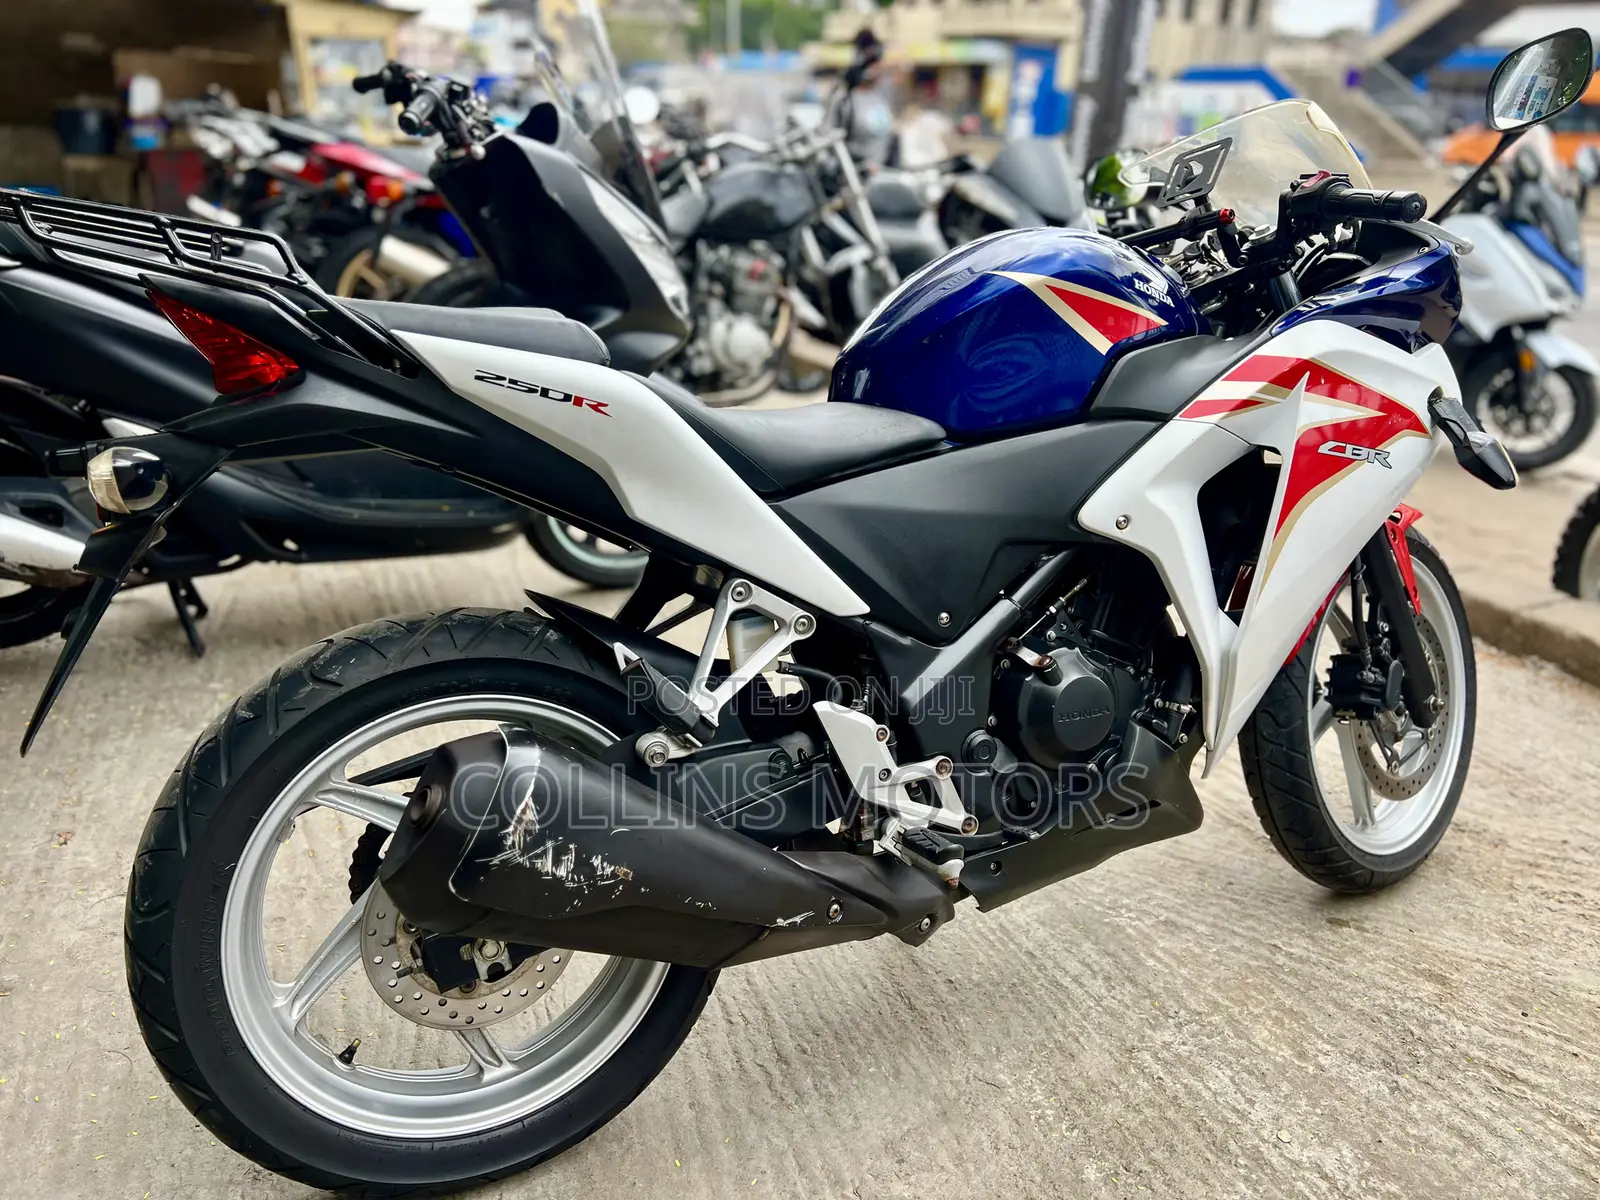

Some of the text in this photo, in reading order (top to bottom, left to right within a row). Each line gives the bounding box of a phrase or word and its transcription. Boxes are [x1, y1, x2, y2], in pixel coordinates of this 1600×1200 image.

[1132, 277, 1176, 308] HONDA
[473, 368, 613, 418] 250R
[1317, 440, 1393, 470] CBR
[1057, 705, 1111, 723] HONDA
